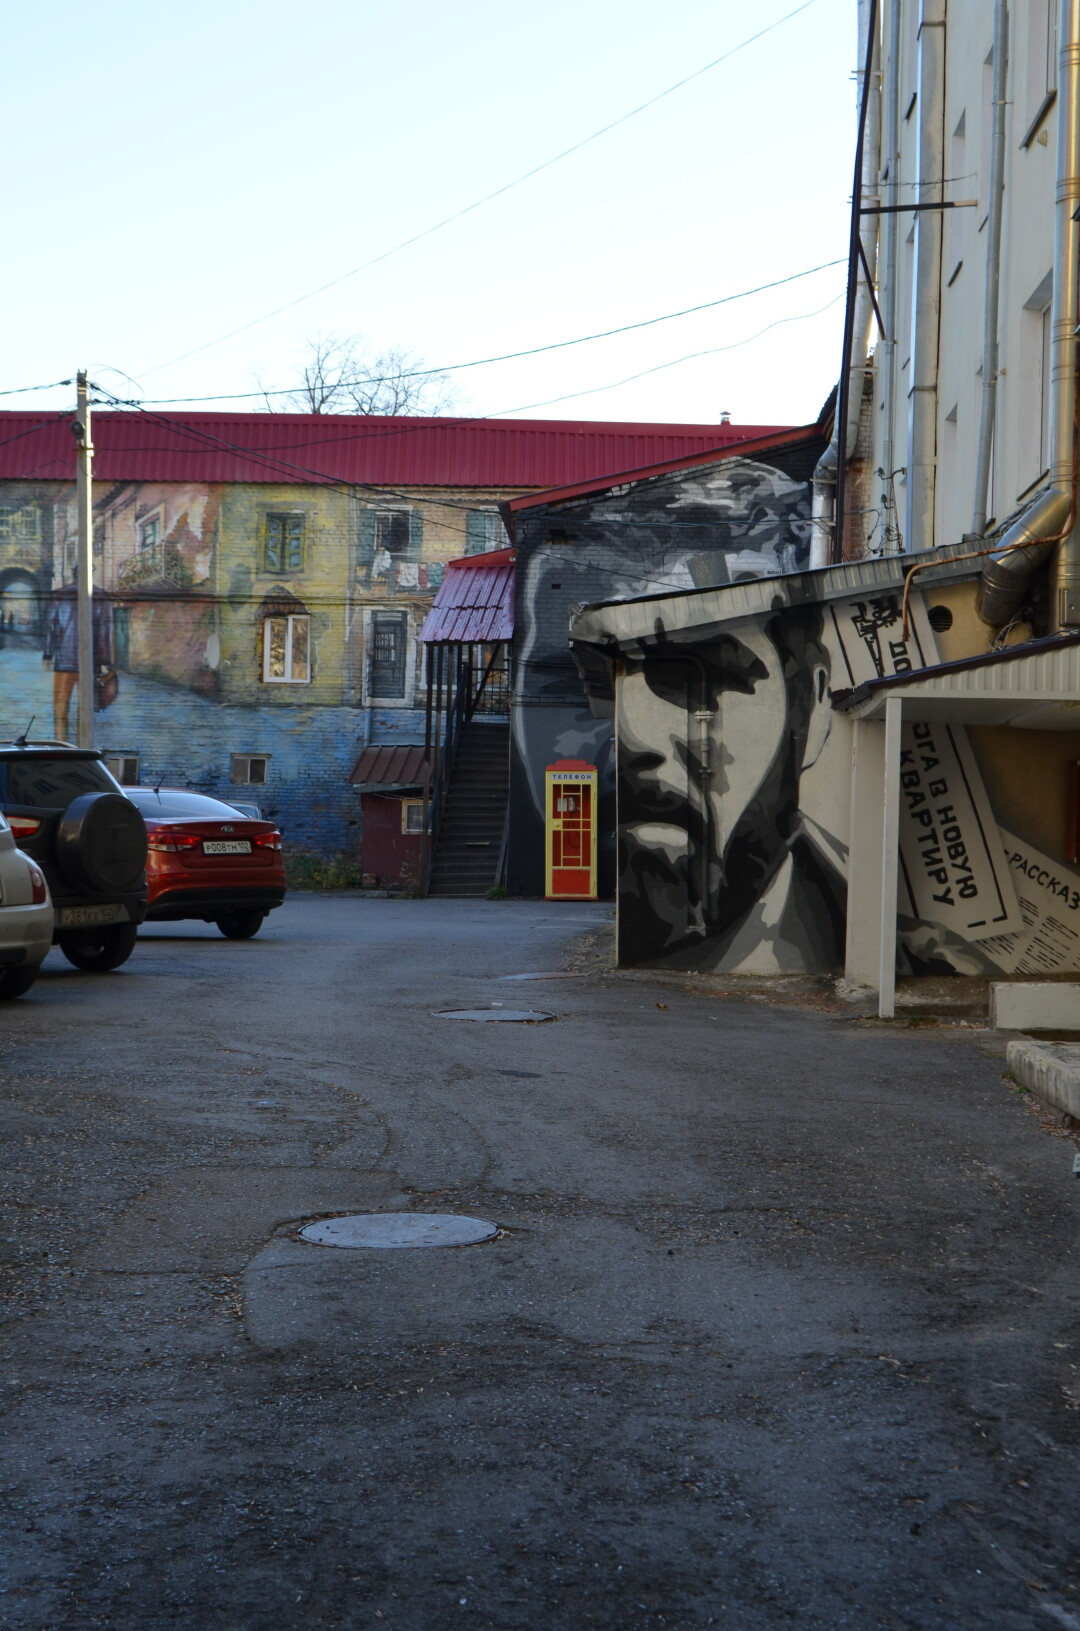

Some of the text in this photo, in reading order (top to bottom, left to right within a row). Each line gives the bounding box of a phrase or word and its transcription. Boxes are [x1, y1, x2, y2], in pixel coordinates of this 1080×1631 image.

[900, 749, 955, 906] КВАРТИРУ
[928, 778, 948, 798] В
[937, 805, 978, 899] НОВУЮ
